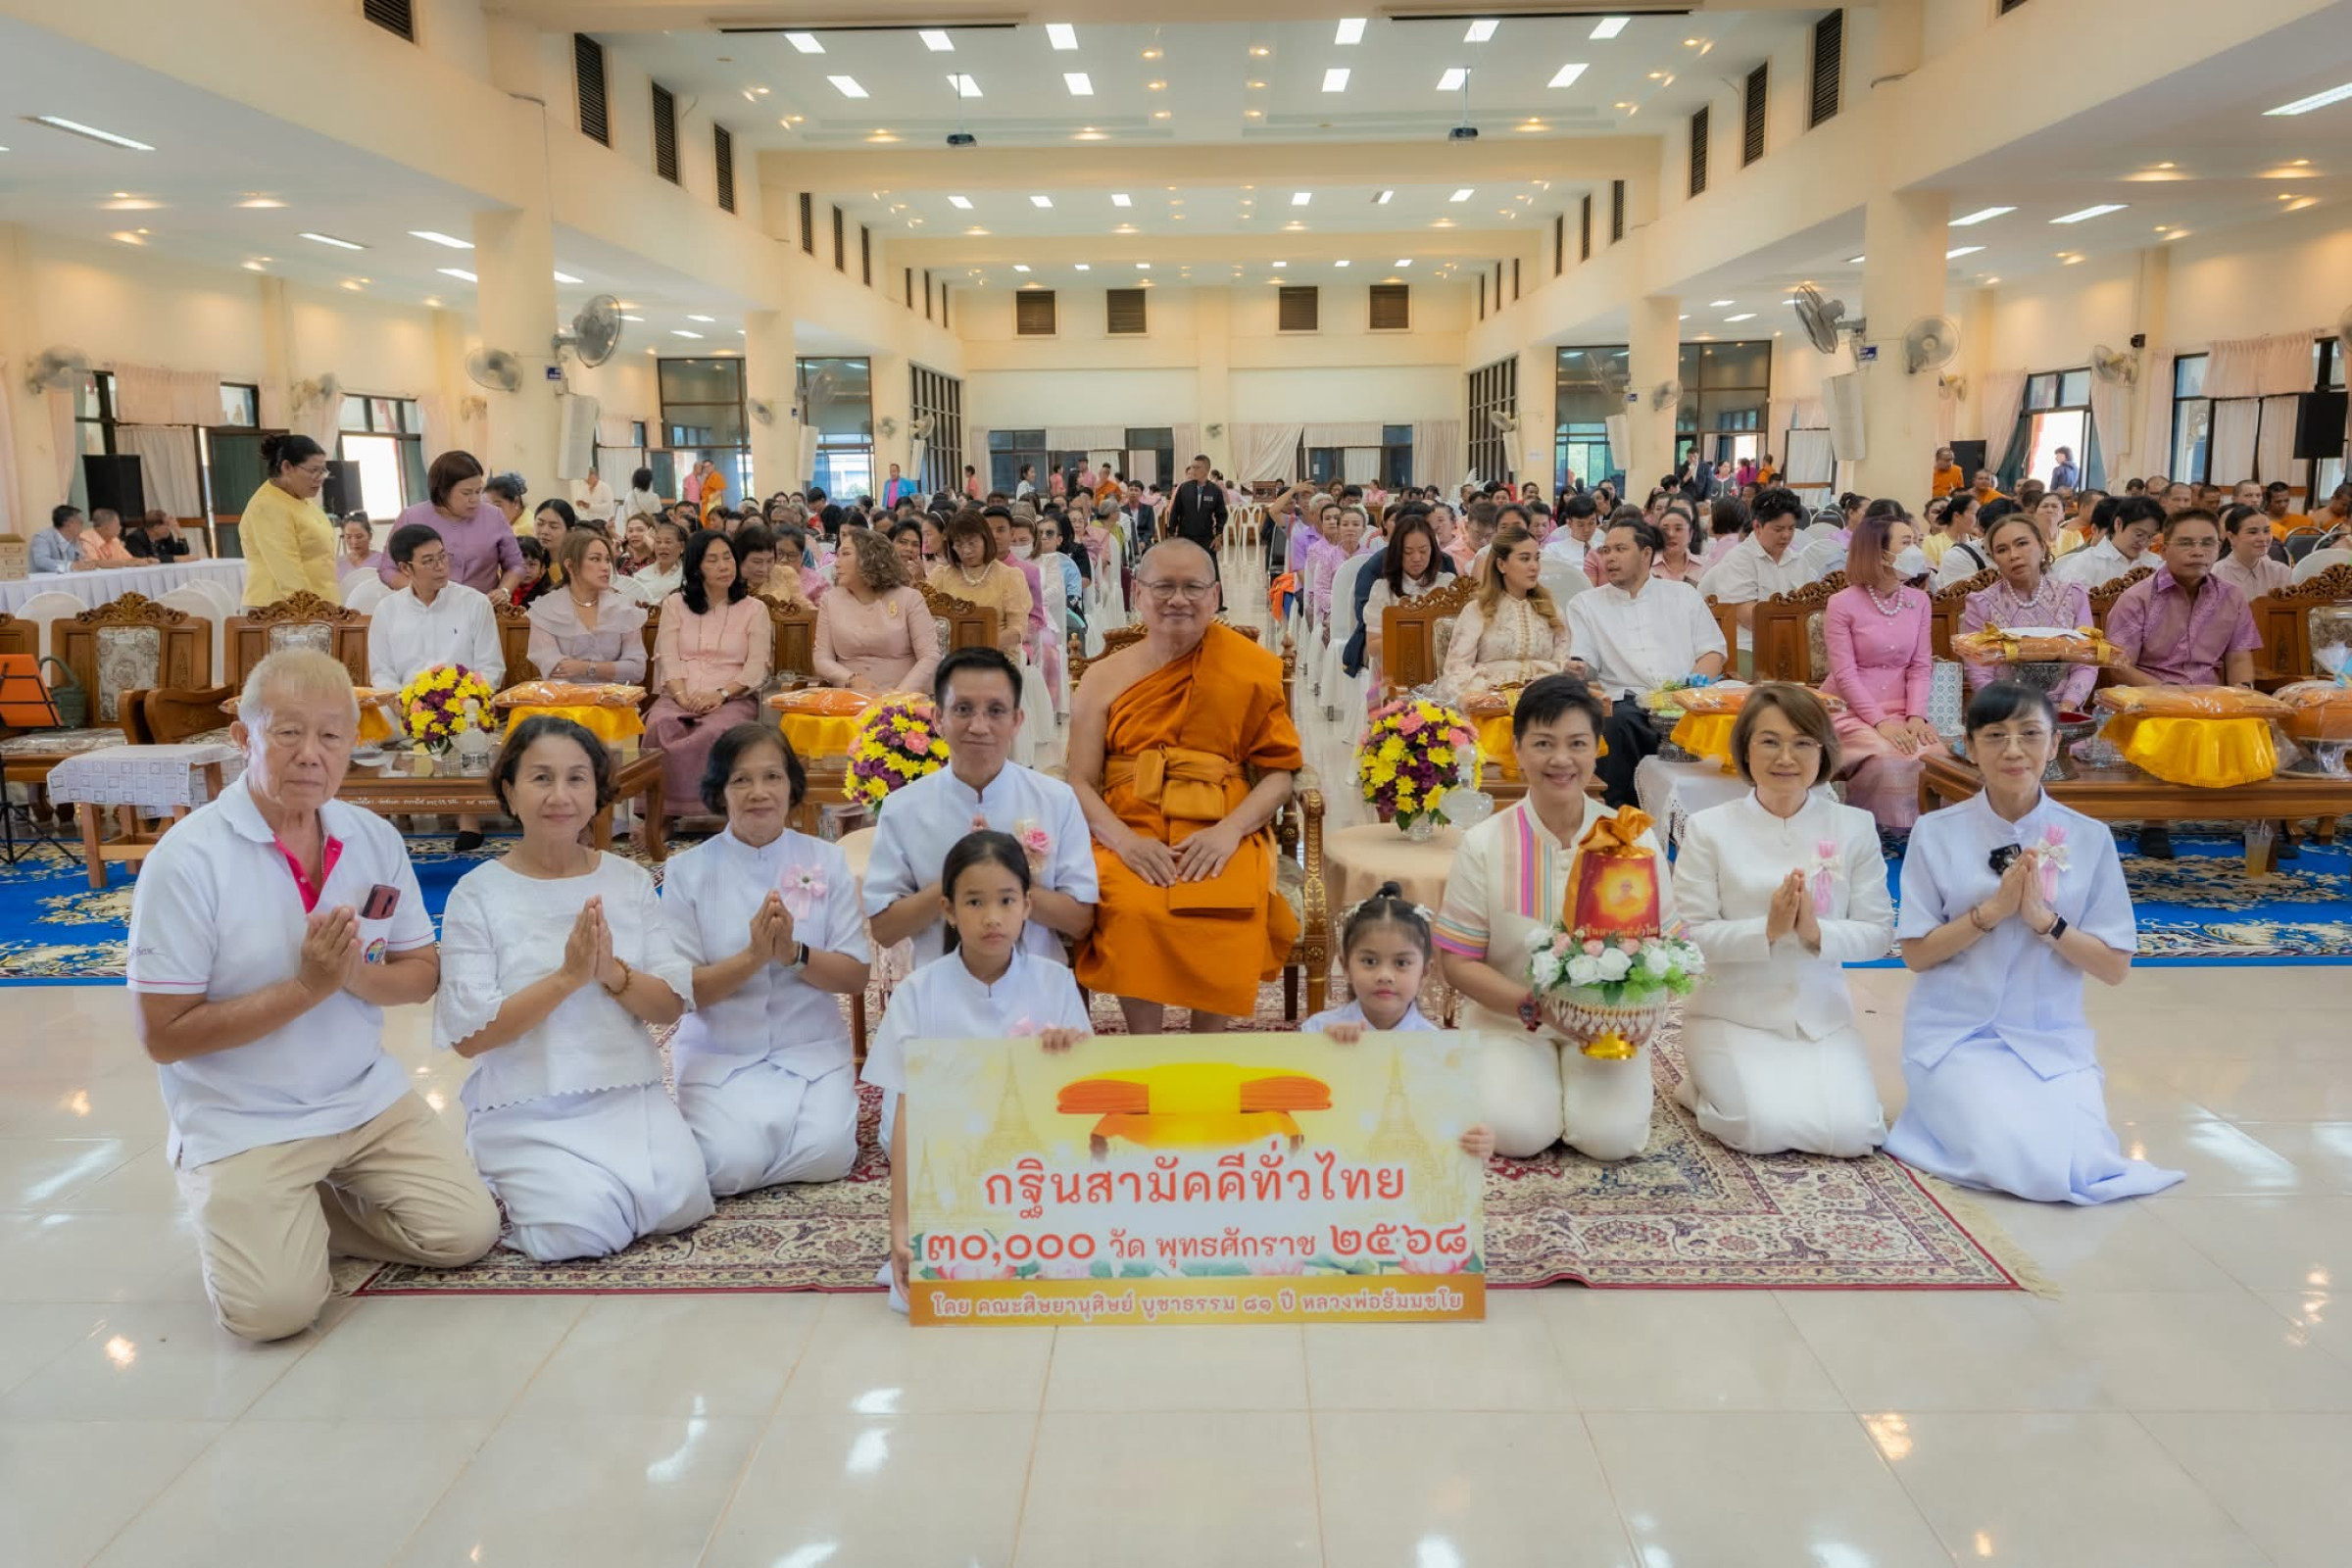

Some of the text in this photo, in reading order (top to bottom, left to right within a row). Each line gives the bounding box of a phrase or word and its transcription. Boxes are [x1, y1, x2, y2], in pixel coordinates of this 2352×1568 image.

[985, 1141, 1404, 1219] กฐินสามัคคีทั่วไทย
[928, 1223, 1467, 1268] ๓๐,๐๐๐ วัด พุทธศักราช ๒๕๖๘
[933, 1294, 969, 1314] โดย
[1279, 1291, 1294, 1310] ปี
